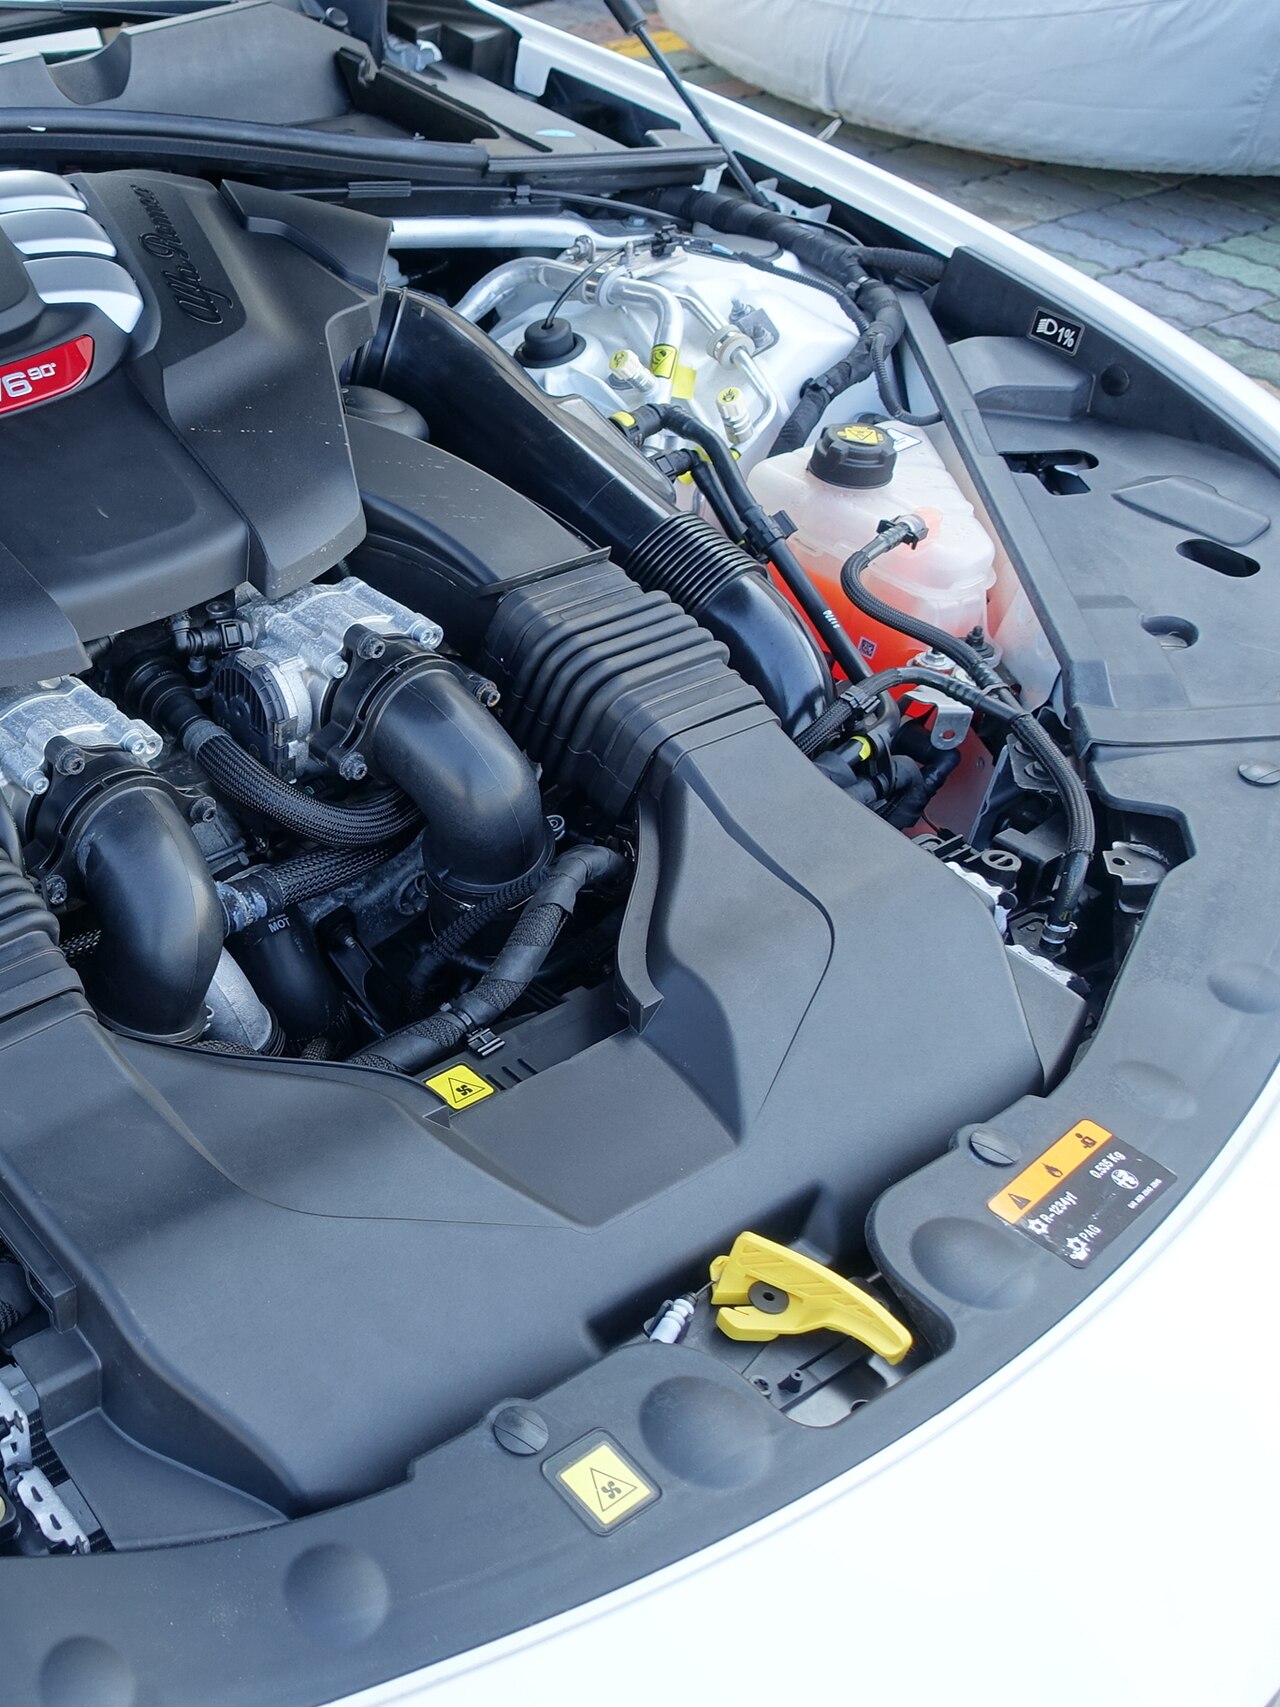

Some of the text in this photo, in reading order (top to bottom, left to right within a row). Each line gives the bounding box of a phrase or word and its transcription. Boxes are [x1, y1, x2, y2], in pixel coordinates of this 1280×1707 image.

[1057, 327, 1076, 348] 1%
[1089, 1156, 1115, 1179] 0.535
[1079, 1224, 1102, 1242] PAG
